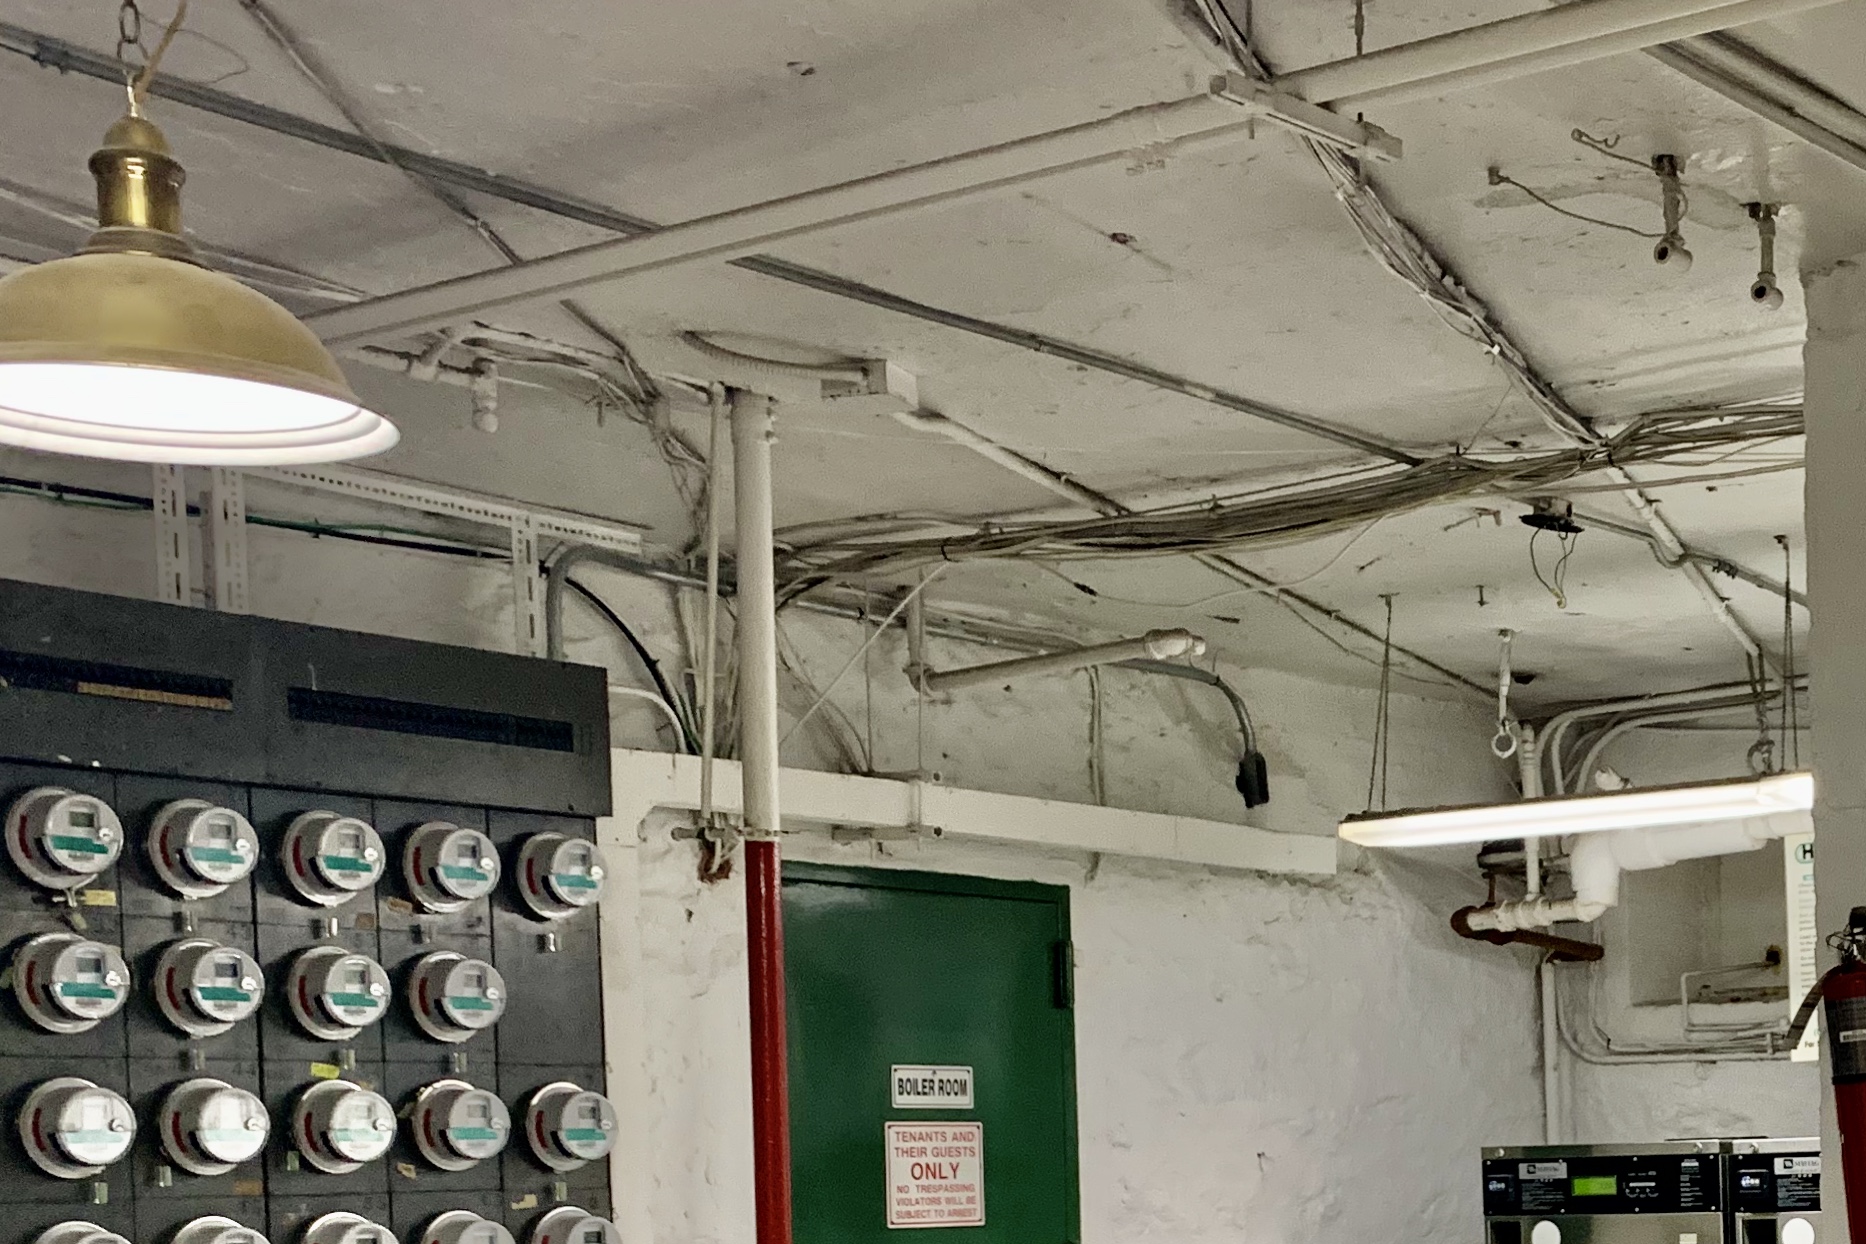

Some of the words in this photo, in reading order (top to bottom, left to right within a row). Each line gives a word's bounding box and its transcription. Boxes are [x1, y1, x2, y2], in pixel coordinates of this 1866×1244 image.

[898, 1078, 935, 1096] BOILER
[939, 1079, 968, 1096] ROOM
[895, 1132, 947, 1142] TENANTS
[952, 1132, 975, 1142] AND
[895, 1147, 927, 1158] THEIR
[931, 1147, 975, 1157] GUESTS
[911, 1162, 960, 1180] ONLY
[897, 1185, 910, 1193] NO
[915, 1184, 975, 1193] TRESPASSING
[896, 1197, 942, 1206] VIOLATORS
[945, 1197, 963, 1205] WILL
[966, 1196, 976, 1204] BE
[896, 1210, 930, 1219] SUBJECT
[947, 1208, 977, 1217] ARREST
